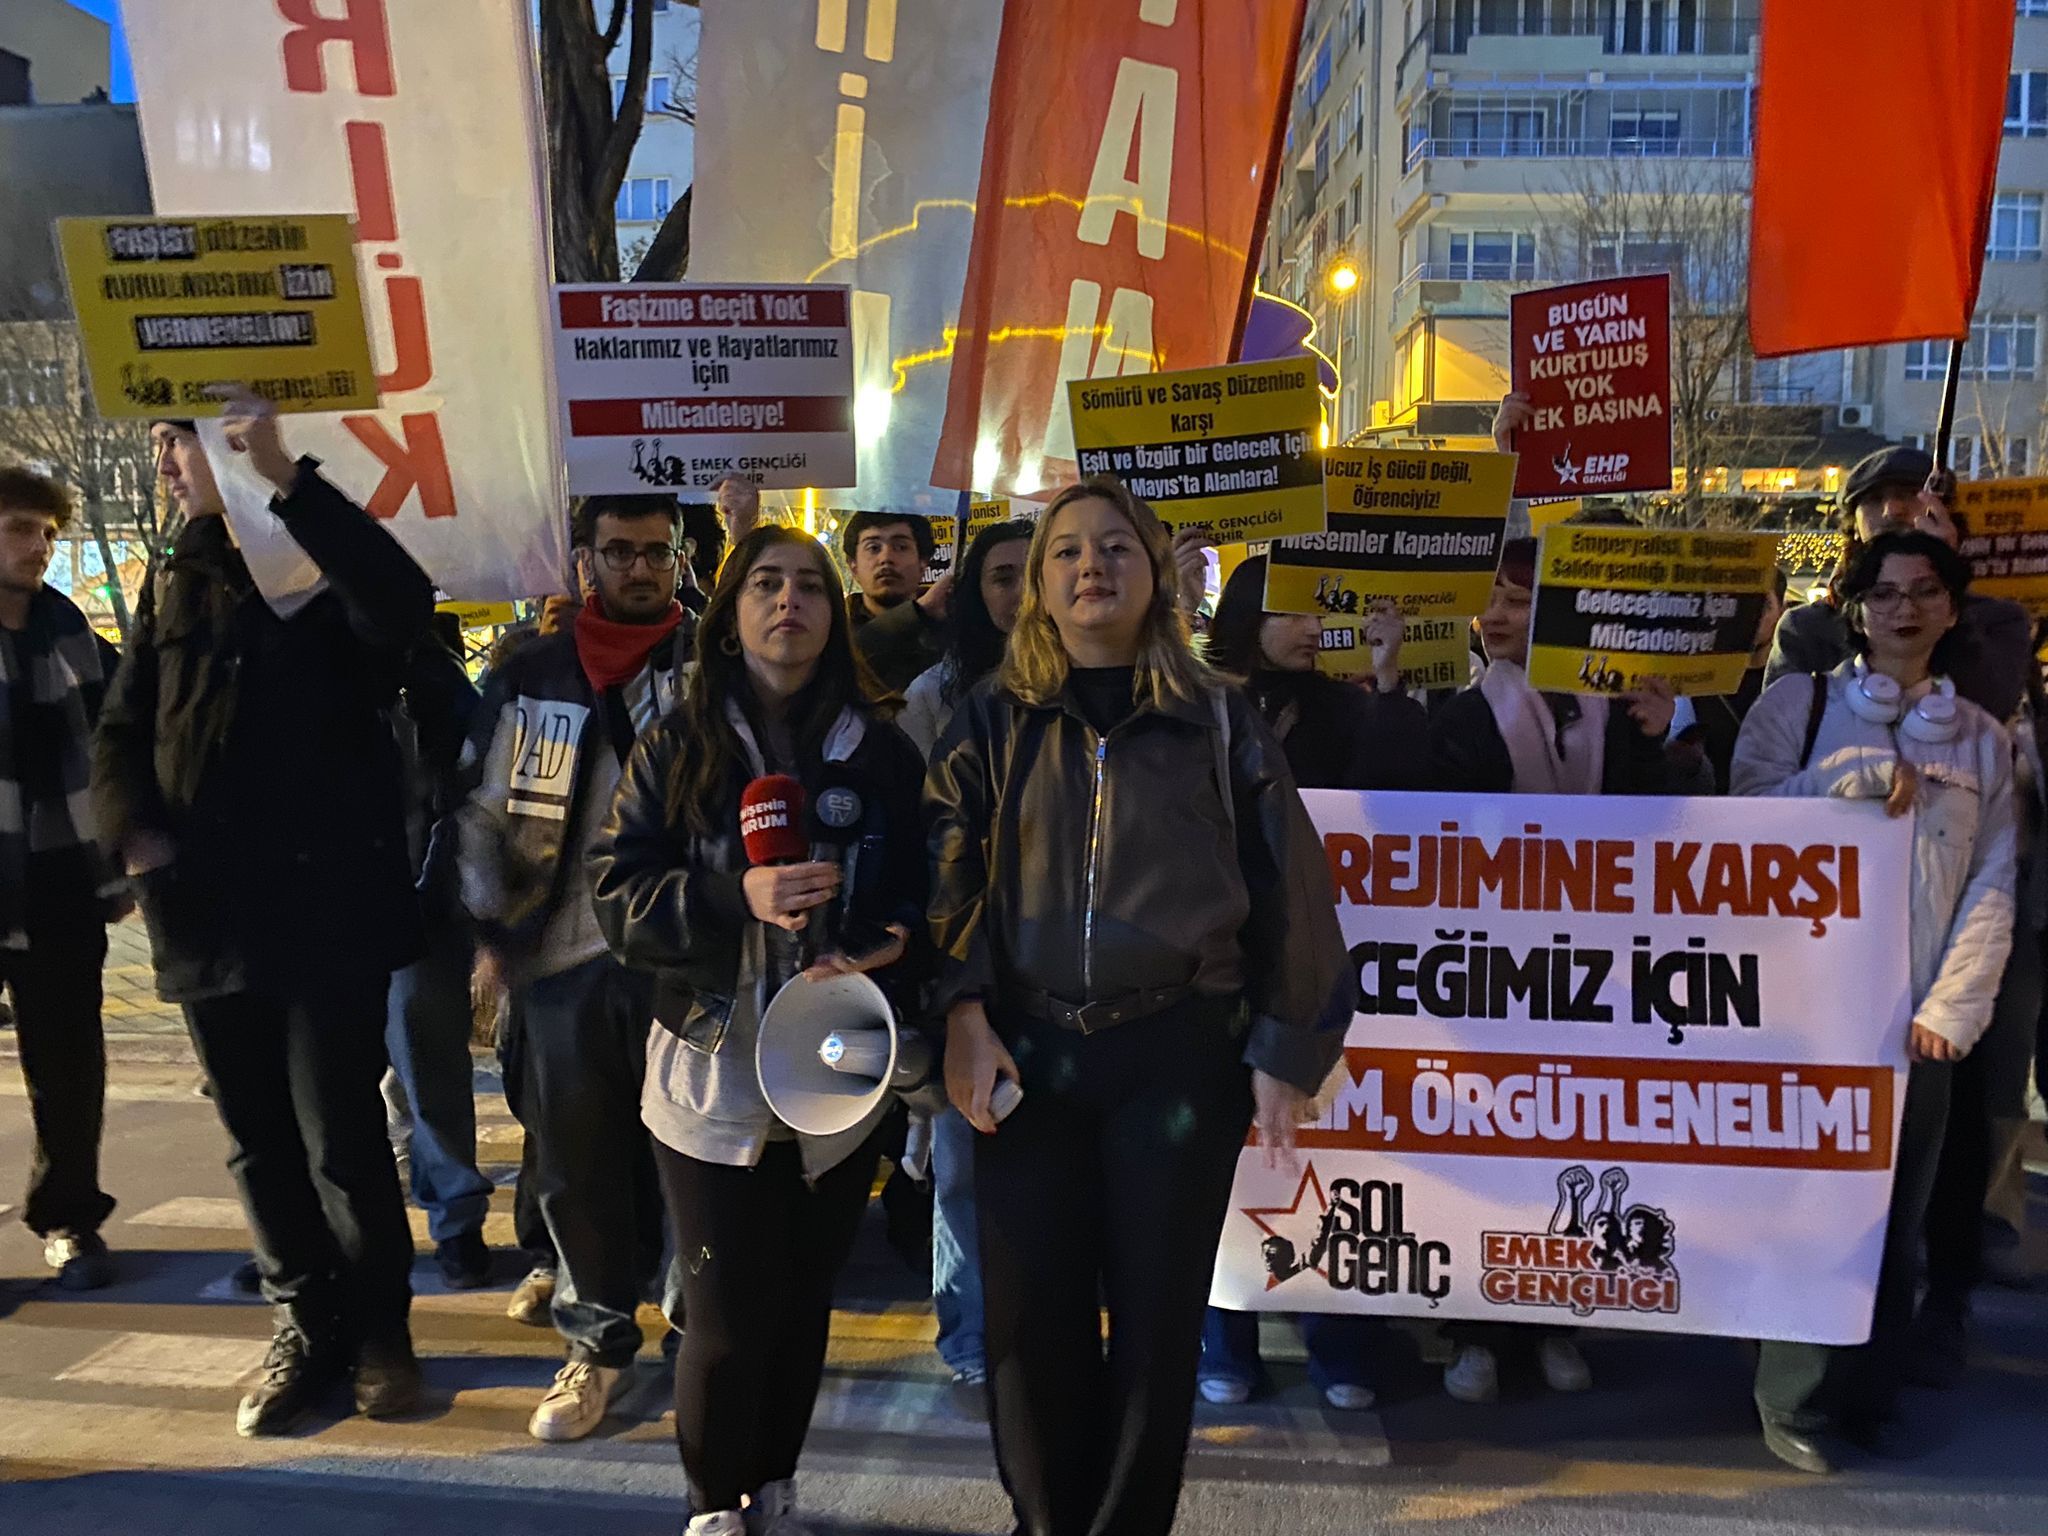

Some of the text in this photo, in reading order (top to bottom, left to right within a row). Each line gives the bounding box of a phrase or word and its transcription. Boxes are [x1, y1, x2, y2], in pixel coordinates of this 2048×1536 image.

[601, 293, 809, 327] Faşizme Geçit Yok!
[1549, 293, 1628, 327] BUGÜN
[574, 335, 839, 363] Haklarımız ve Hayatlarımız
[1532, 318, 1646, 354] VE YARIN
[692, 359, 730, 391] için
[1530, 344, 1649, 380] KURTULUŞ
[1081, 370, 1306, 412] Sömürü ve Savaş Düzenine
[1565, 374, 1615, 401] YOK
[641, 401, 785, 431] Mücadeleye!
[1171, 413, 1213, 436] Karşı
[1574, 394, 1662, 426] BAŞINA
[691, 453, 806, 471] EMEK GENÇLİĞİ
[1082, 450, 1110, 477] Eşit
[1113, 452, 1133, 470] ve
[1135, 445, 1181, 470] Özgür
[1185, 443, 1208, 465] bir
[1212, 436, 1280, 462] Gelecek
[1324, 457, 1362, 478] Ucuz
[1387, 456, 1424, 481] Gücü
[1430, 457, 1472, 484] Değil,
[1584, 454, 1629, 474] EHP
[1204, 466, 1279, 492] Alanlara!
[1582, 472, 1627, 485] GENÇLİĞİ
[1353, 484, 1441, 511] Öğrenciyiz!
[1218, 509, 1283, 531] GENÇLİĞİ
[1392, 530, 1496, 559] Kapatılsın!
[1324, 821, 1861, 937] REJİMİNE KARŞI
[1632, 937, 1761, 1044] İÇİN
[1411, 1059, 1871, 1152] ÖRGÜTLENELİM!
[1331, 1179, 1414, 1235] SOL
[1486, 1236, 1596, 1270] EMEK
[1483, 1270, 1678, 1312] GENÇLİĞİ
